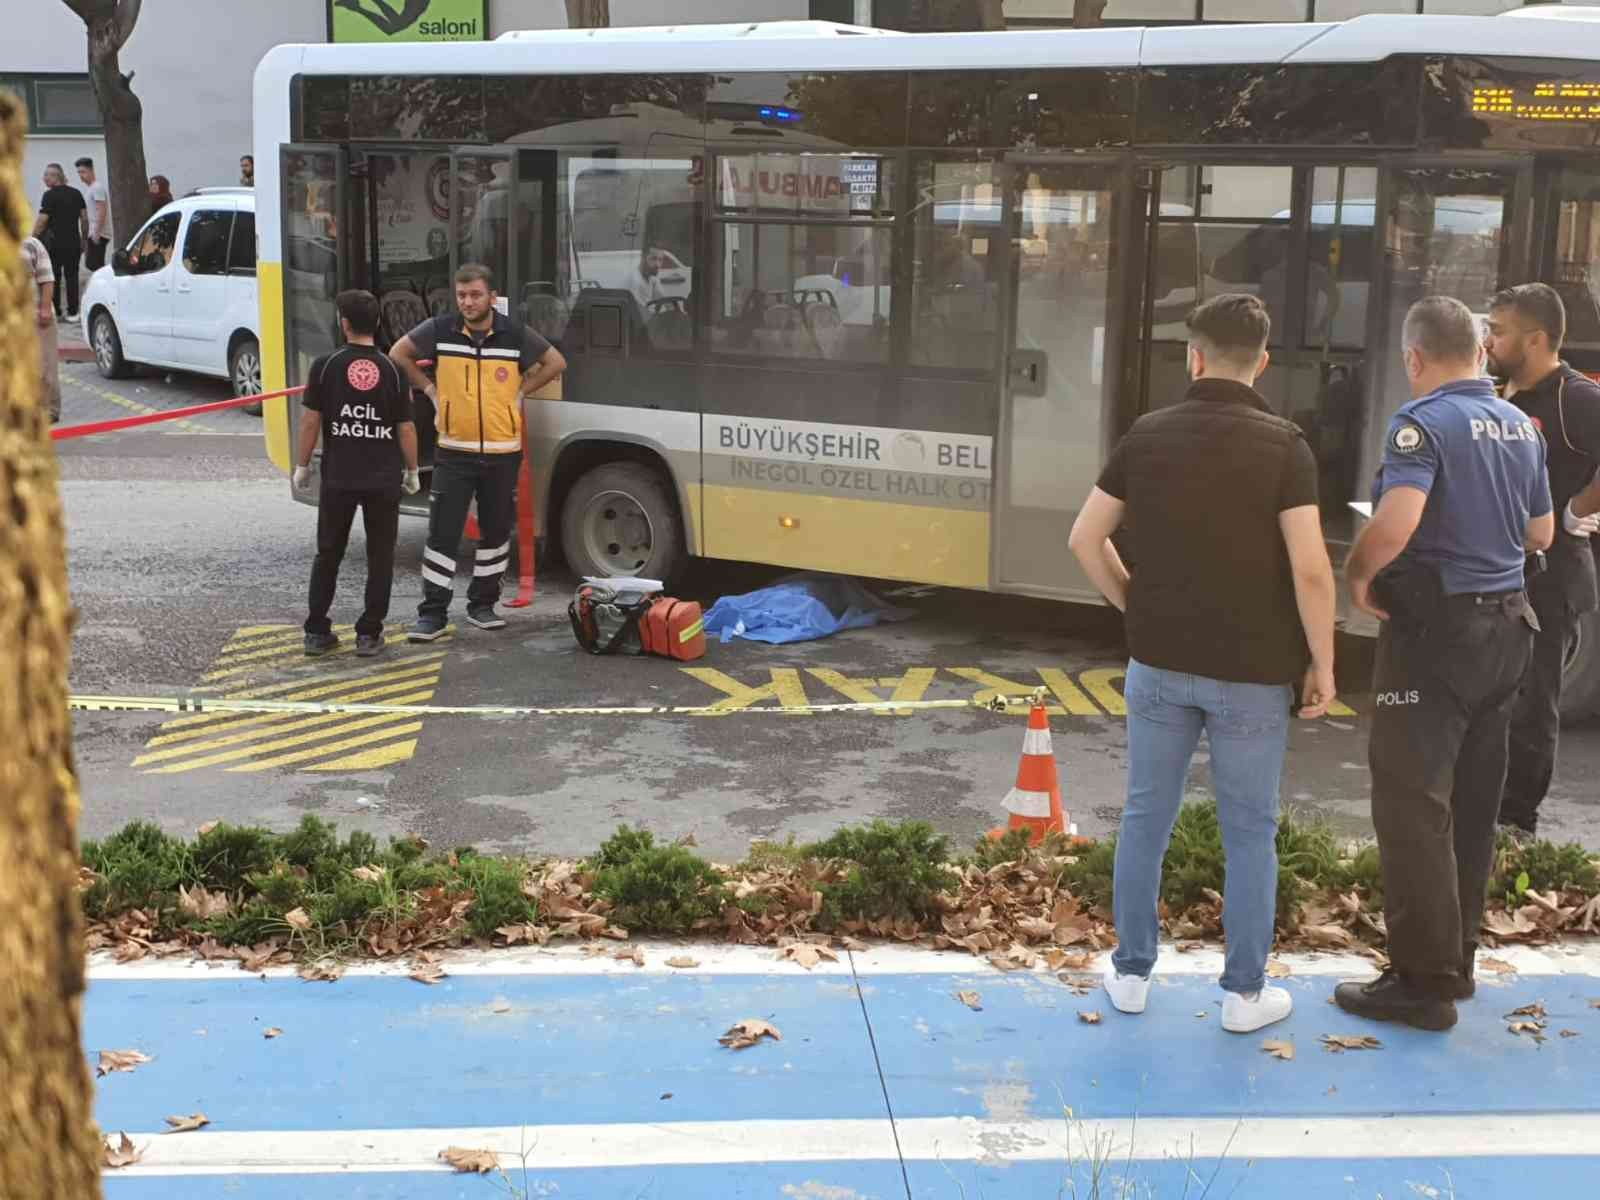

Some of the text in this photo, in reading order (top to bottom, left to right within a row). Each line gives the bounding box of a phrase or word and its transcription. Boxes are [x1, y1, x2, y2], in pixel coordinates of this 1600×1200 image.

[418, 17, 476, 35] saloni
[340, 402, 382, 421] ACİL
[332, 421, 393, 440] SAĞLIK
[719, 422, 988, 470] BÜYÜKŞEHİR BEL
[820, 463, 881, 492] ÖZEL
[886, 473, 953, 499] HALK
